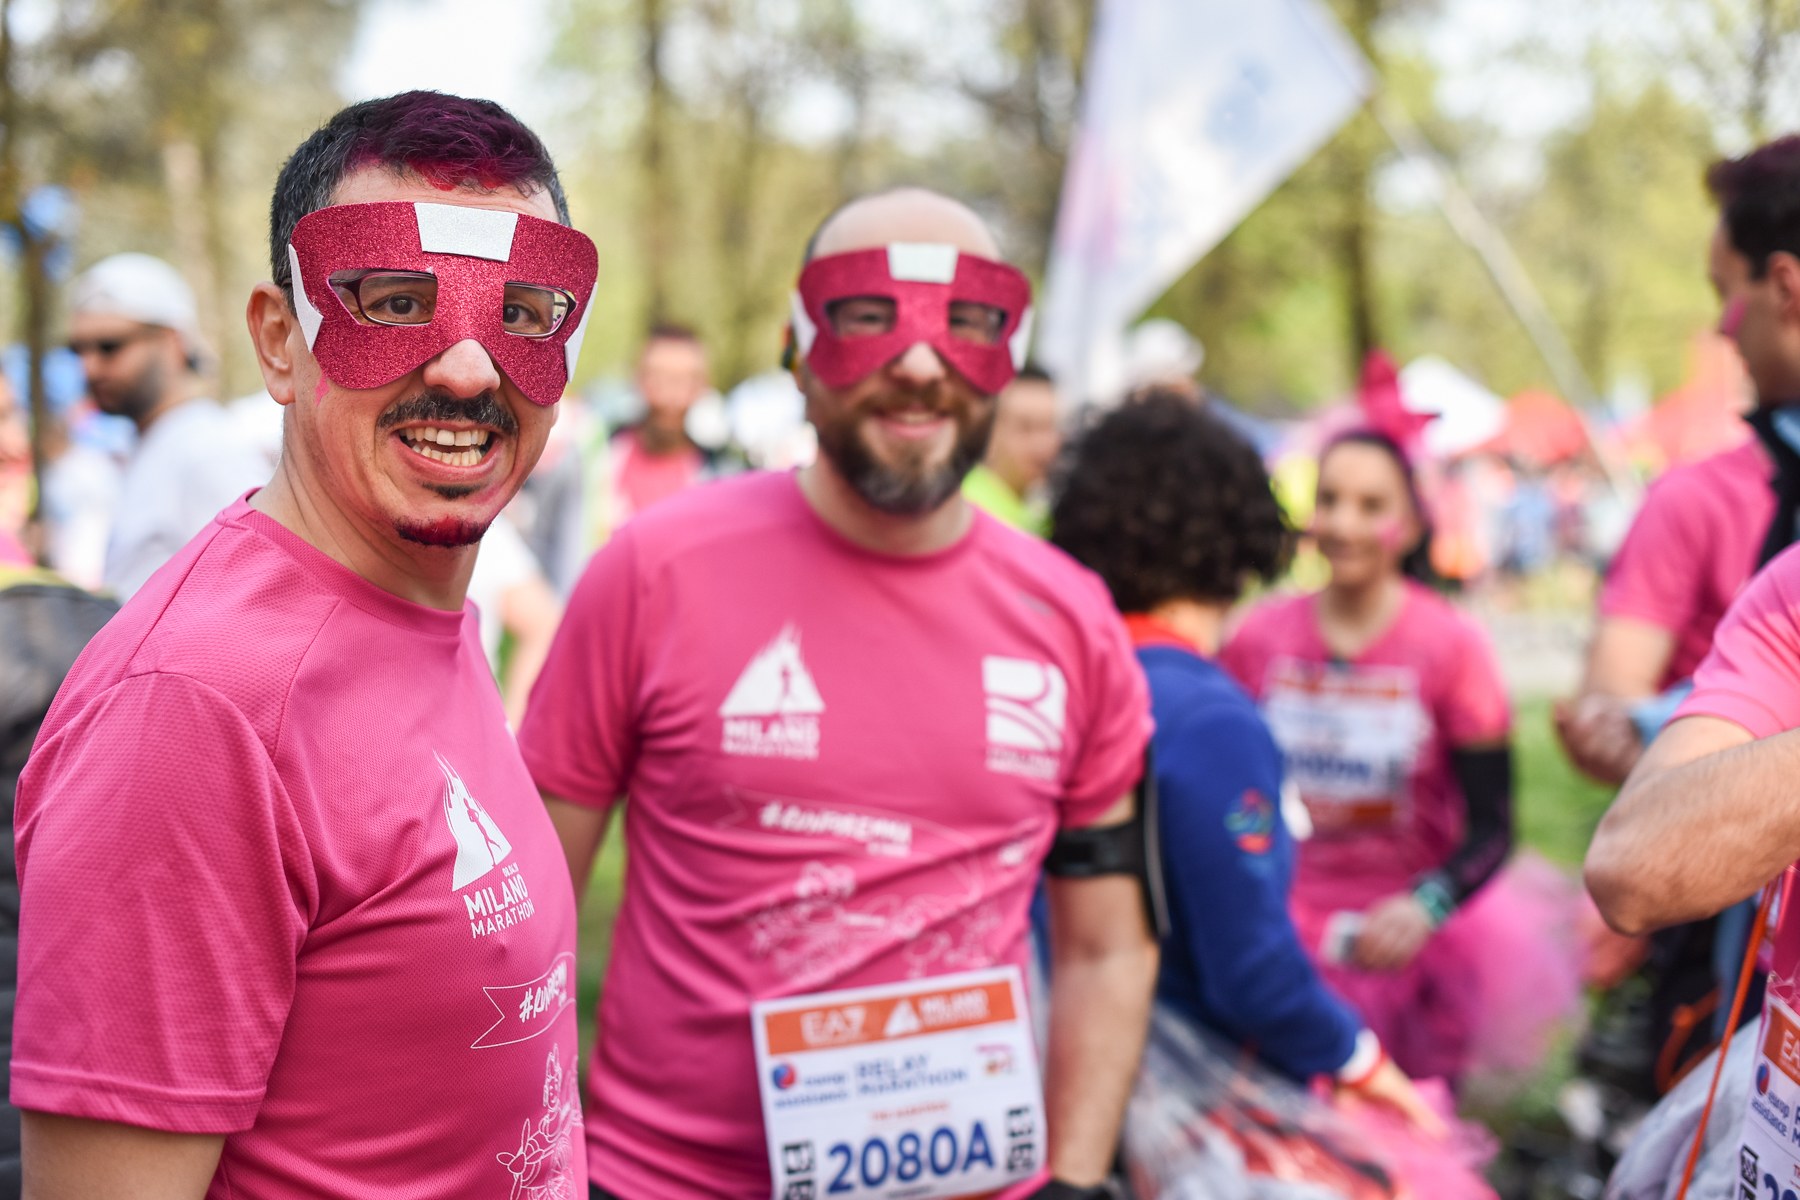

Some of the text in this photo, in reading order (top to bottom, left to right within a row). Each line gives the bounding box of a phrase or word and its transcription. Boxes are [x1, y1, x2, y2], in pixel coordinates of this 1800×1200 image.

[723, 719, 820, 743] MILANO
[463, 873, 529, 920] MILANO
[470, 898, 535, 939] MARATHON
[826, 1120, 995, 1195] 2080A
